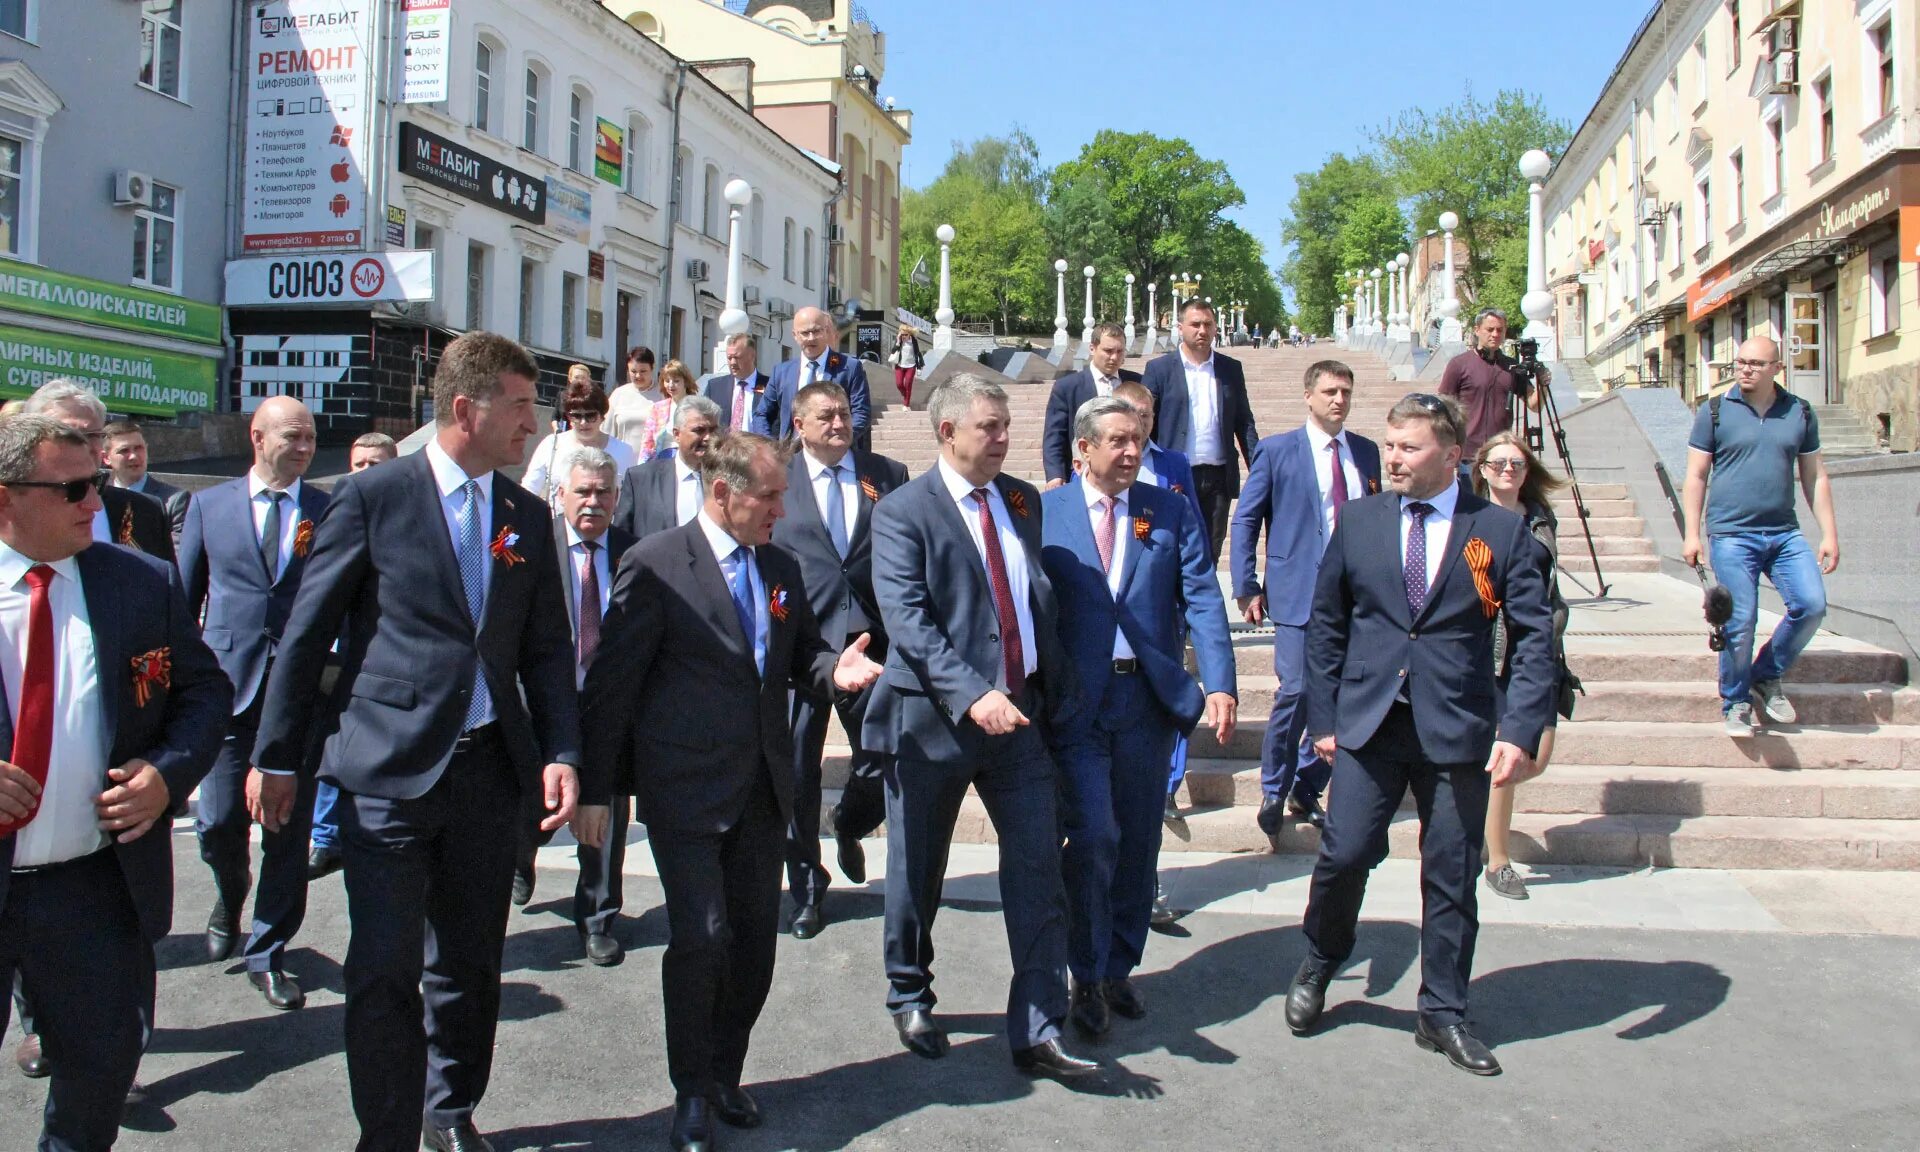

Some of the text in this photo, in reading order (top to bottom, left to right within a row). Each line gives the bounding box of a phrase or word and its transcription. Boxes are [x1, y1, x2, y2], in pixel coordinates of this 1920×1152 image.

[282, 11, 359, 29] МЕГАБИТ
[405, 30, 440, 40] ASUS
[414, 47, 441, 57] Apple
[258, 46, 357, 75] РЕМОНТ
[405, 64, 440, 72] SONY
[257, 73, 357, 90] ЦИФРОВОЙ ТЕХНИКИ
[404, 79, 439, 87] lenovo
[402, 91, 440, 100] SAMSUNG
[262, 128, 304, 139] Ноутбуков
[262, 142, 306, 152] Планшетов
[262, 156, 305, 167] Телефонов
[417, 137, 481, 180] МЕГАБИТ
[261, 168, 317, 179] Техники Apple
[416, 161, 480, 192] СЕРВИСНЫЙ ЦЕНТР
[261, 183, 316, 193] Компьютеров
[260, 197, 312, 207] Телевизоров
[260, 211, 304, 221] Мониторов
[249, 235, 345, 247] www.megabit32.ru 2 этаж
[268, 259, 344, 299] СОЮЗ
[0, 273, 186, 326] МЕТАЛЛОИСКАТЕЛЕЙ
[79, 355, 156, 382] ИЗДЕЛИЙ,
[114, 379, 126, 399] И
[130, 381, 208, 408] ПОДАРКОВ
